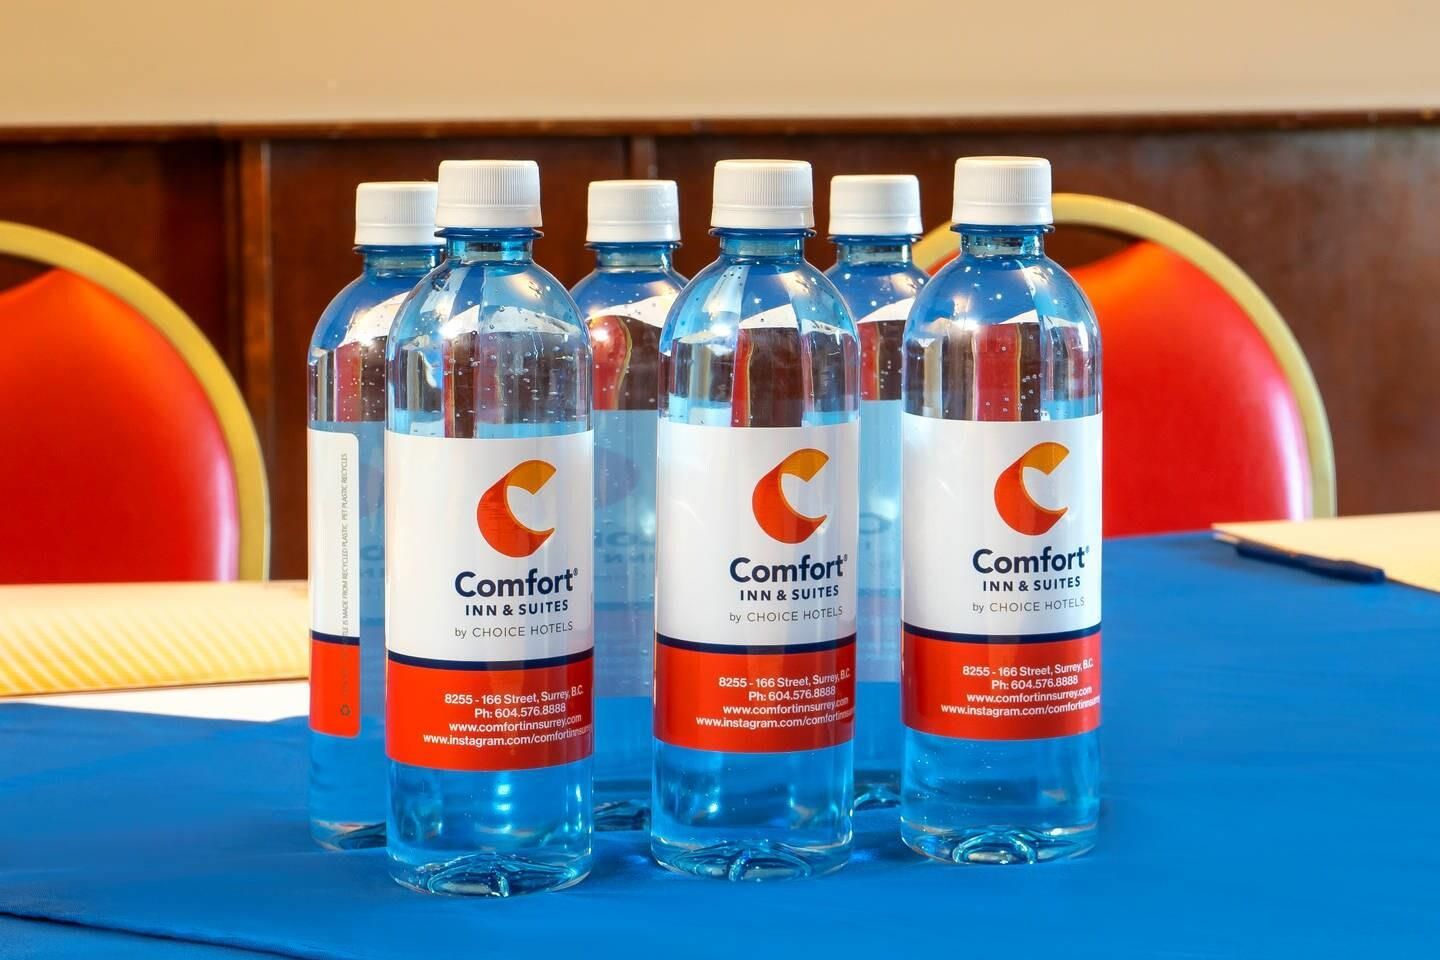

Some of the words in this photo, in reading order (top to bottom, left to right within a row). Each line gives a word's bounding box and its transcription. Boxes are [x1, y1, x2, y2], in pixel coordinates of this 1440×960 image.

[983, 581, 1013, 592] INN
[1018, 580, 1029, 592] &
[1034, 576, 1080, 591] SUITES
[740, 590, 771, 601] INN
[776, 589, 787, 601] &
[791, 585, 839, 600] SUITES
[465, 605, 497, 616] INN
[502, 604, 513, 616] &
[518, 599, 568, 615] SUITES
[972, 602, 984, 614] by
[990, 602, 1040, 612] CHOICE
[1045, 596, 1084, 610] HOTELS
[729, 613, 741, 623] by
[747, 611, 798, 622] CHOICE
[803, 605, 843, 620] HOTELS
[455, 628, 467, 639] by
[472, 626, 526, 638] CHOICE
[530, 621, 573, 636] HOTELS
[962, 665, 990, 676] 8255
[999, 667, 1018, 677] 166
[1019, 665, 1053, 676] Street,
[718, 676, 747, 688] 8255
[756, 678, 775, 688] 166
[777, 676, 811, 688] Street,
[991, 680, 1009, 690] Ph:
[1011, 675, 1078, 689] 604.576.8888
[444, 693, 473, 704] 8255
[482, 694, 502, 705] 166
[503, 693, 540, 705] Street,
[748, 691, 766, 701] Ph:
[768, 685, 835, 701] 604.576.8888
[966, 686, 1092, 703] www.comfortinnsurrey.com
[474, 708, 493, 719] Ph:
[494, 703, 566, 718] 604.576.8888
[722, 696, 849, 715] www.comfortinnsurrey.com
[448, 714, 582, 733] www.comfortinnsurrey.com
